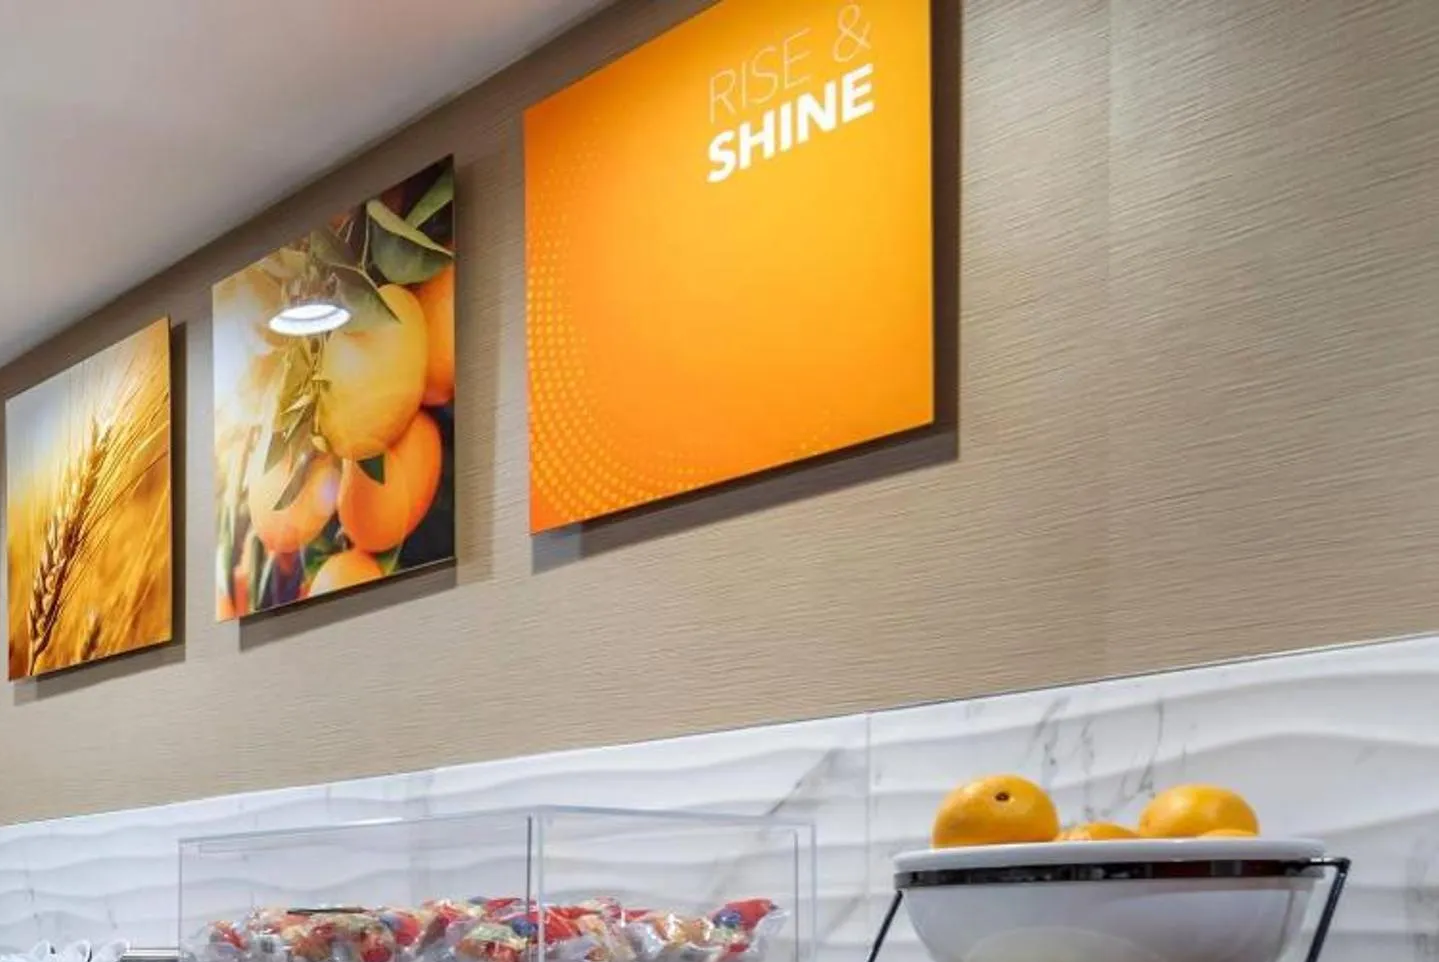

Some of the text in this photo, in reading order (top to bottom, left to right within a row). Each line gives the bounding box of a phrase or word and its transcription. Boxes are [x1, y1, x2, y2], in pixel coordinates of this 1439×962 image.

[707, 63, 874, 182] SHINE
[710, 3, 871, 123] RISE &
